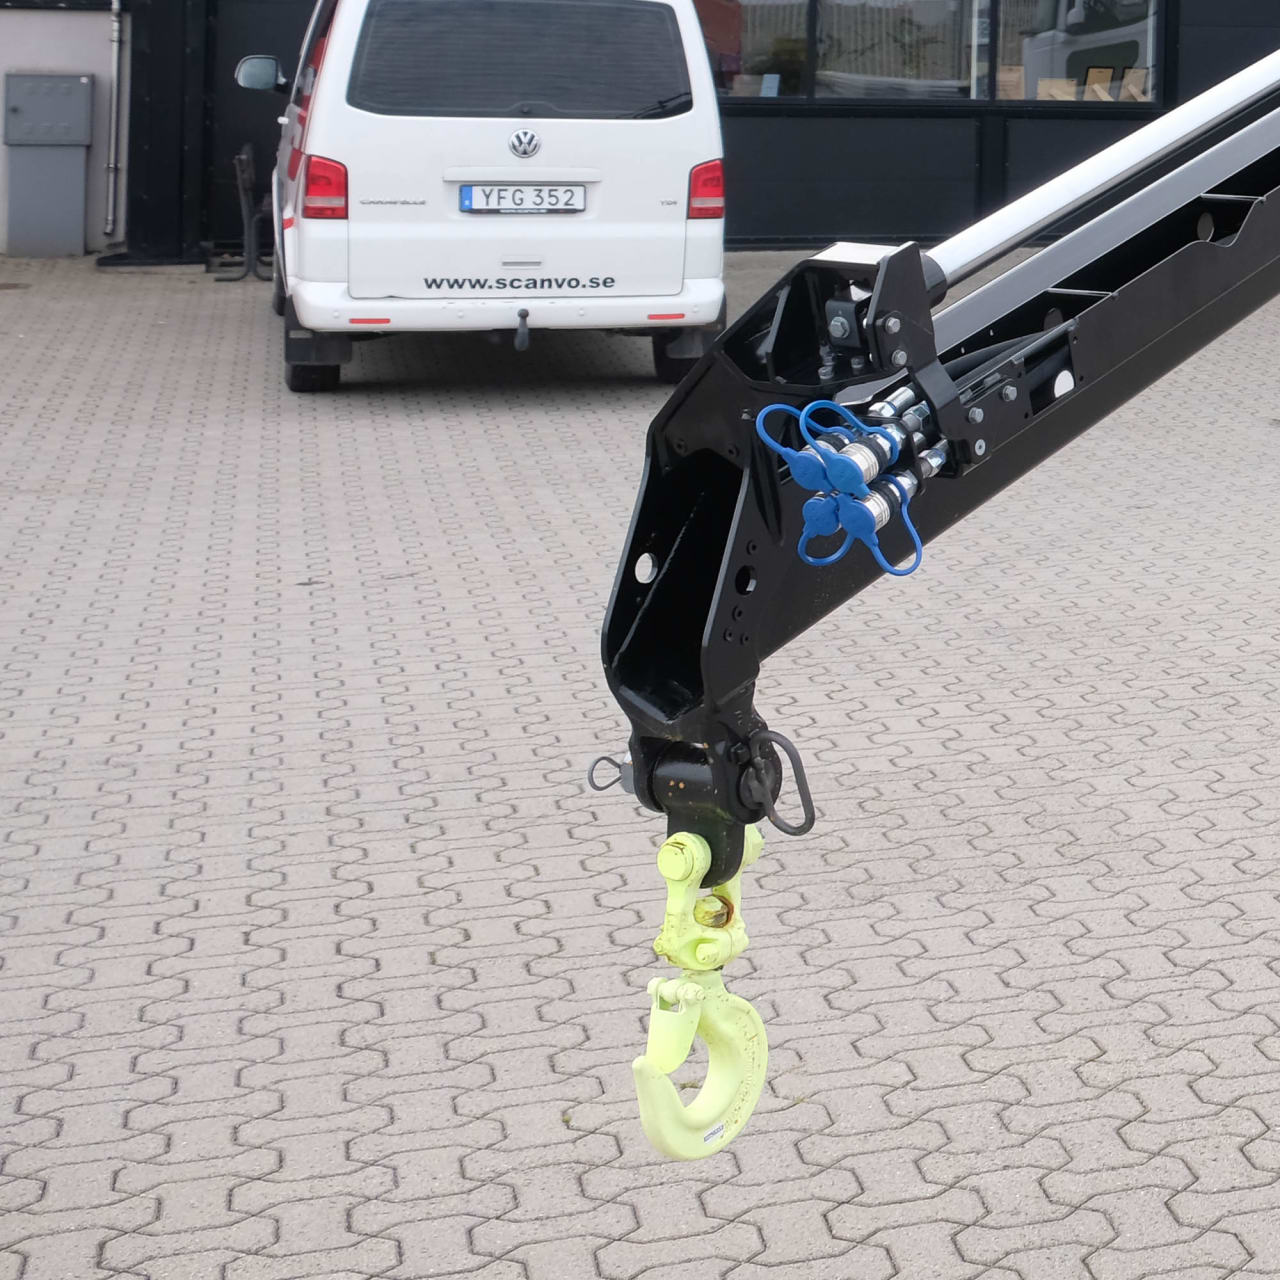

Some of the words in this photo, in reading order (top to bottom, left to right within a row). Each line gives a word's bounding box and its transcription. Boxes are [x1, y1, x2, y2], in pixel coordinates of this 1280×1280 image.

[481, 188, 525, 207] YFG
[532, 188, 575, 207] 352
[423, 276, 616, 290] www.scanvo.se
